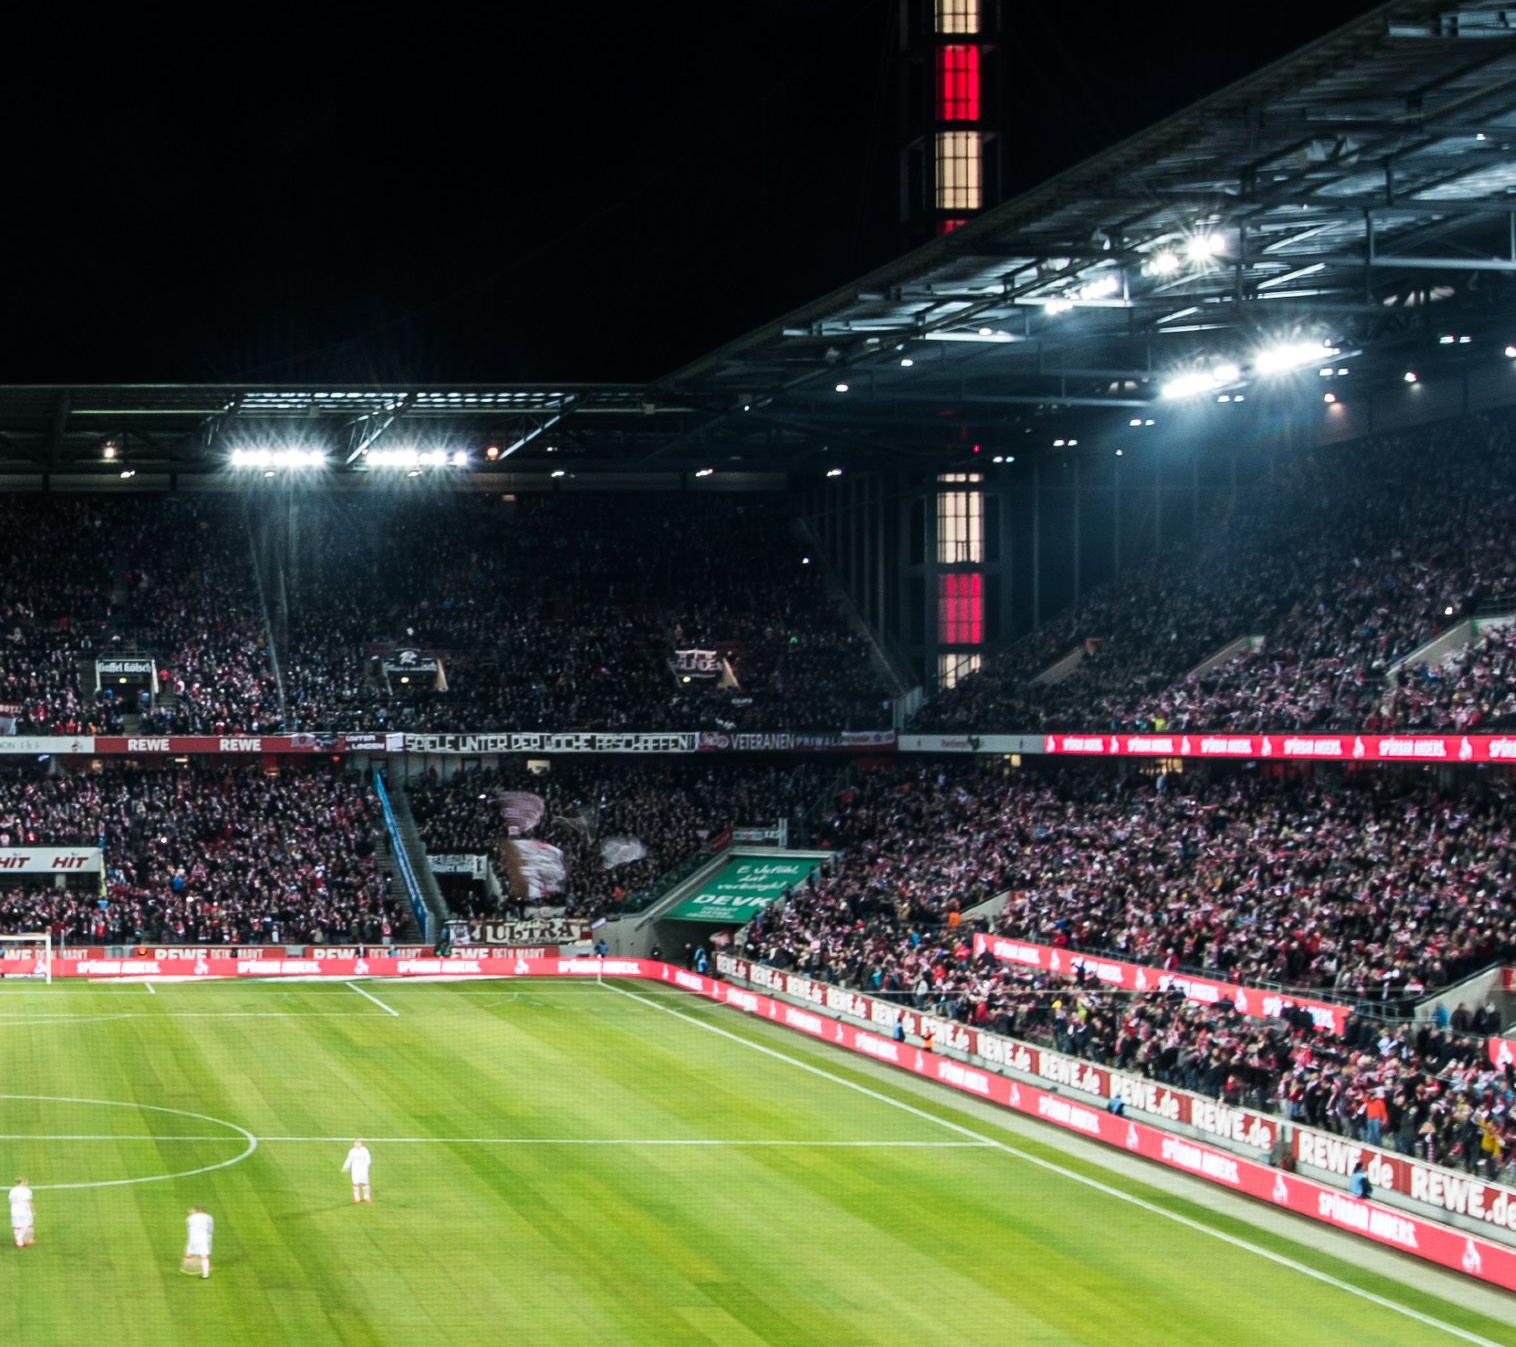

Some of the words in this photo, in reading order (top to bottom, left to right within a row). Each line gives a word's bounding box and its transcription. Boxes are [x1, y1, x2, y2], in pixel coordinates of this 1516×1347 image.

[128, 739, 169, 752] REWE
[220, 739, 262, 752] REWE
[458, 735, 508, 751] UNTER
[510, 735, 541, 751] DER
[731, 734, 795, 750] VETERANEN
[52, 856, 89, 869] HIT
[692, 894, 774, 908] DEVK
[1038, 1052, 1101, 1097] REWE.de
[1109, 1073, 1180, 1122] REWE.de
[1191, 1096, 1273, 1151] REWE.de
[1297, 1127, 1395, 1192] REWEde
[1318, 1189, 1369, 1234] SPÜRBAR
